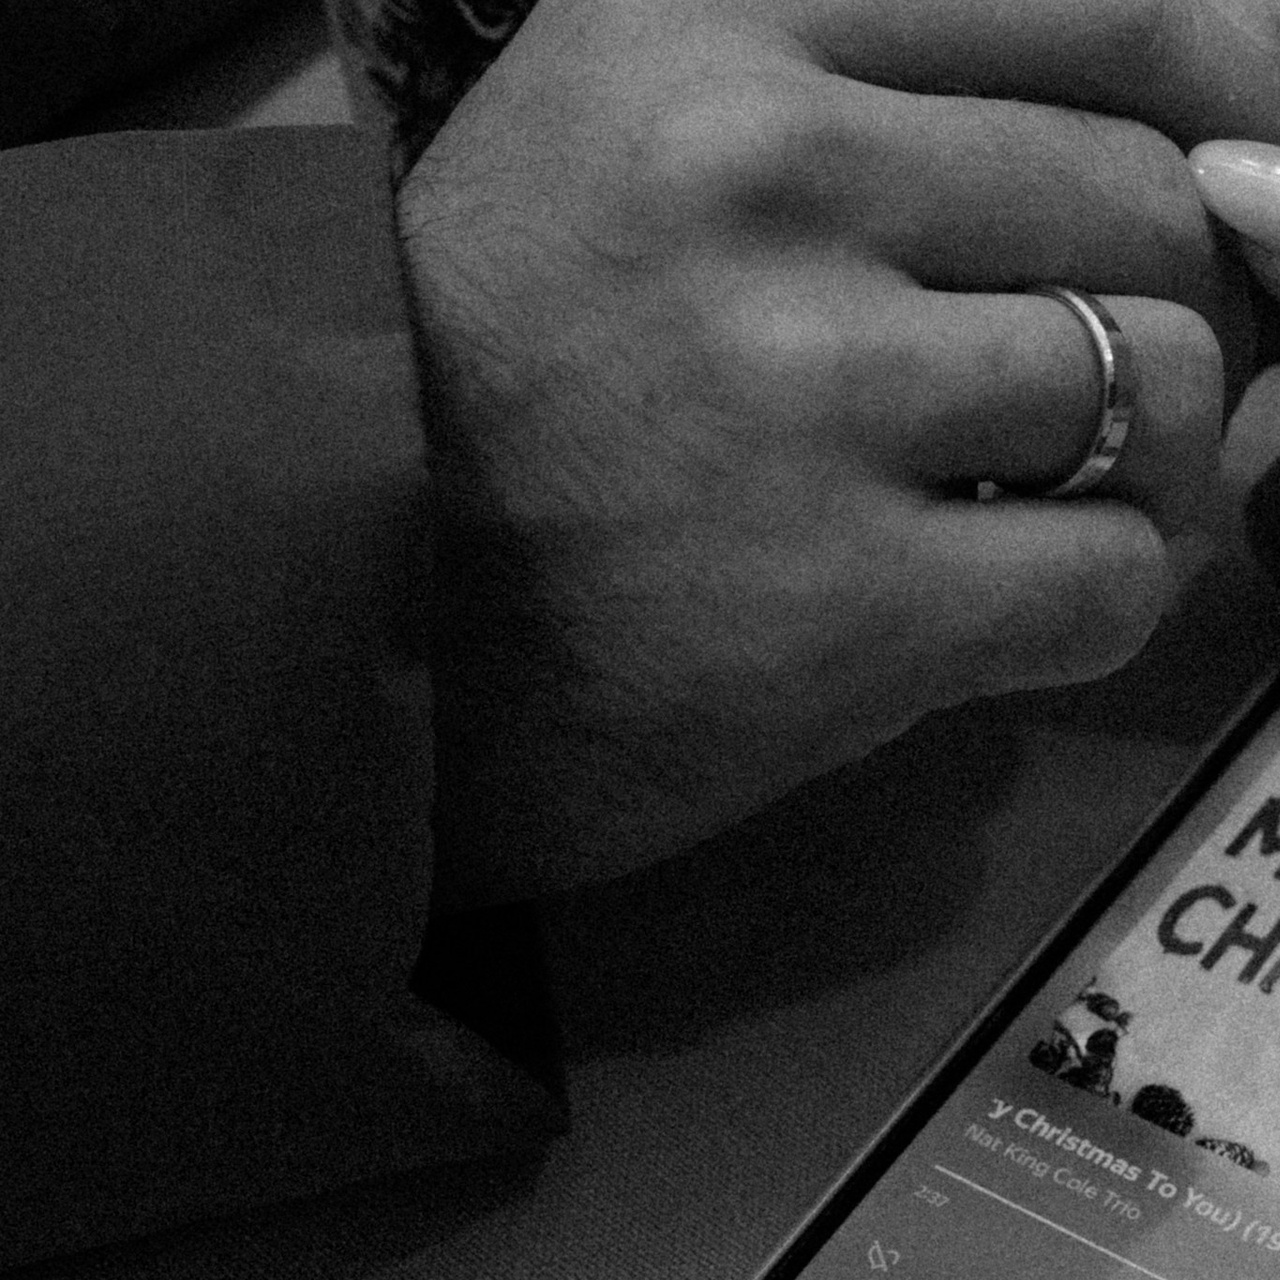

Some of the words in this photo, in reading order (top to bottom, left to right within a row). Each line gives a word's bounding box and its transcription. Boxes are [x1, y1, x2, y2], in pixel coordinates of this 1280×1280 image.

[913, 1185, 951, 1208] 2:37
[964, 1123, 1004, 1152] Nat
[1003, 1142, 1050, 1178] King
[1052, 1167, 1099, 1200] Cole
[1102, 1189, 1142, 1221] Trio
[987, 1098, 1014, 1120] y
[1014, 1108, 1142, 1182] Christmas
[1147, 1169, 1178, 1199] To
[1182, 1187, 1243, 1232] You)
